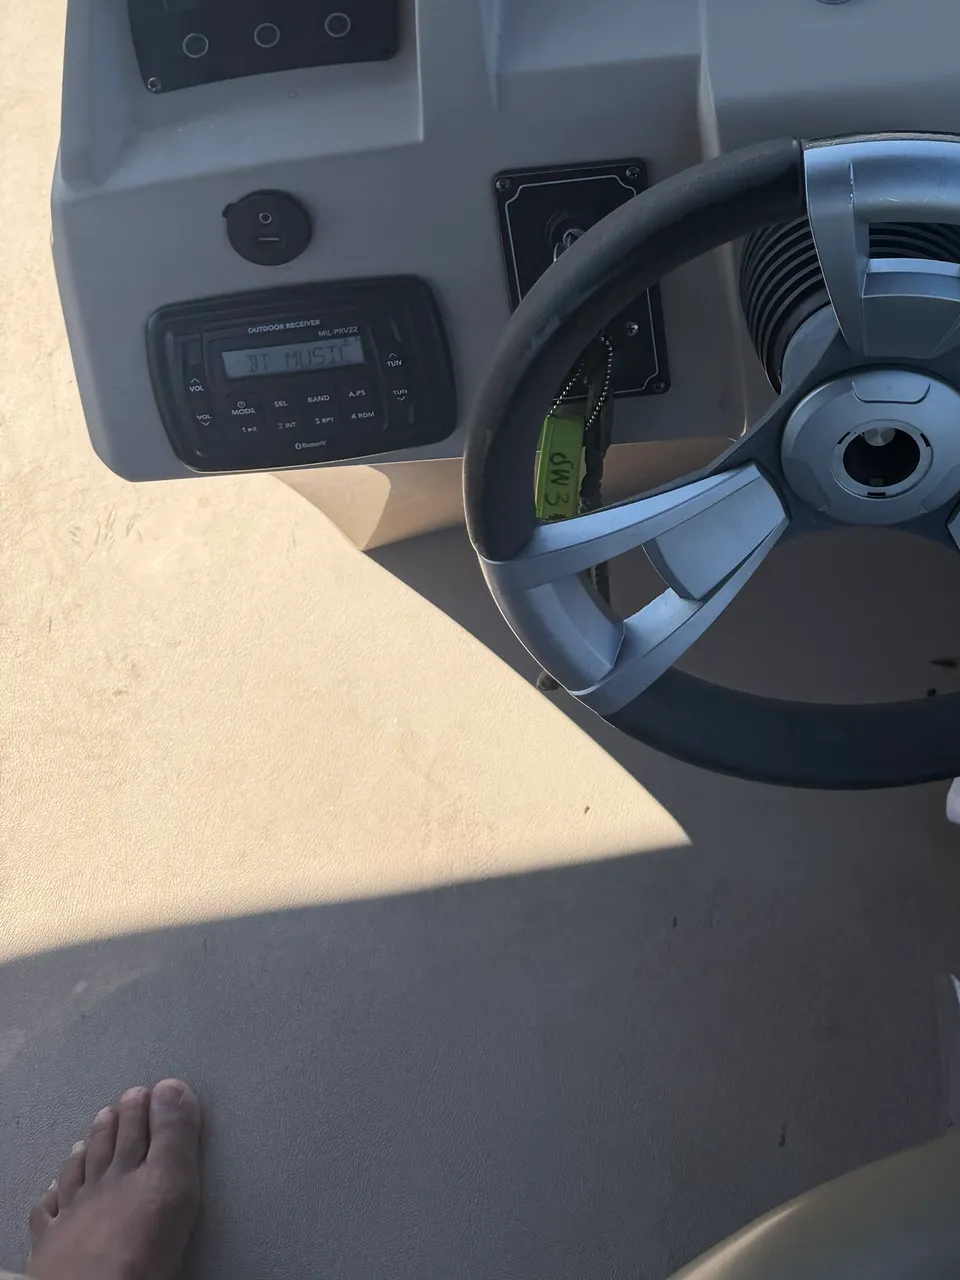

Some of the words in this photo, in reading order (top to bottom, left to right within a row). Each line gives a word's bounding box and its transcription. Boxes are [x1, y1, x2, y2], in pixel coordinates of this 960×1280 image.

[248, 324, 284, 334] OUTDOOR
[286, 319, 320, 329] RECEIVER
[387, 359, 402, 367] TUN
[307, 395, 330, 403] BAND
[274, 400, 288, 408] SEL
